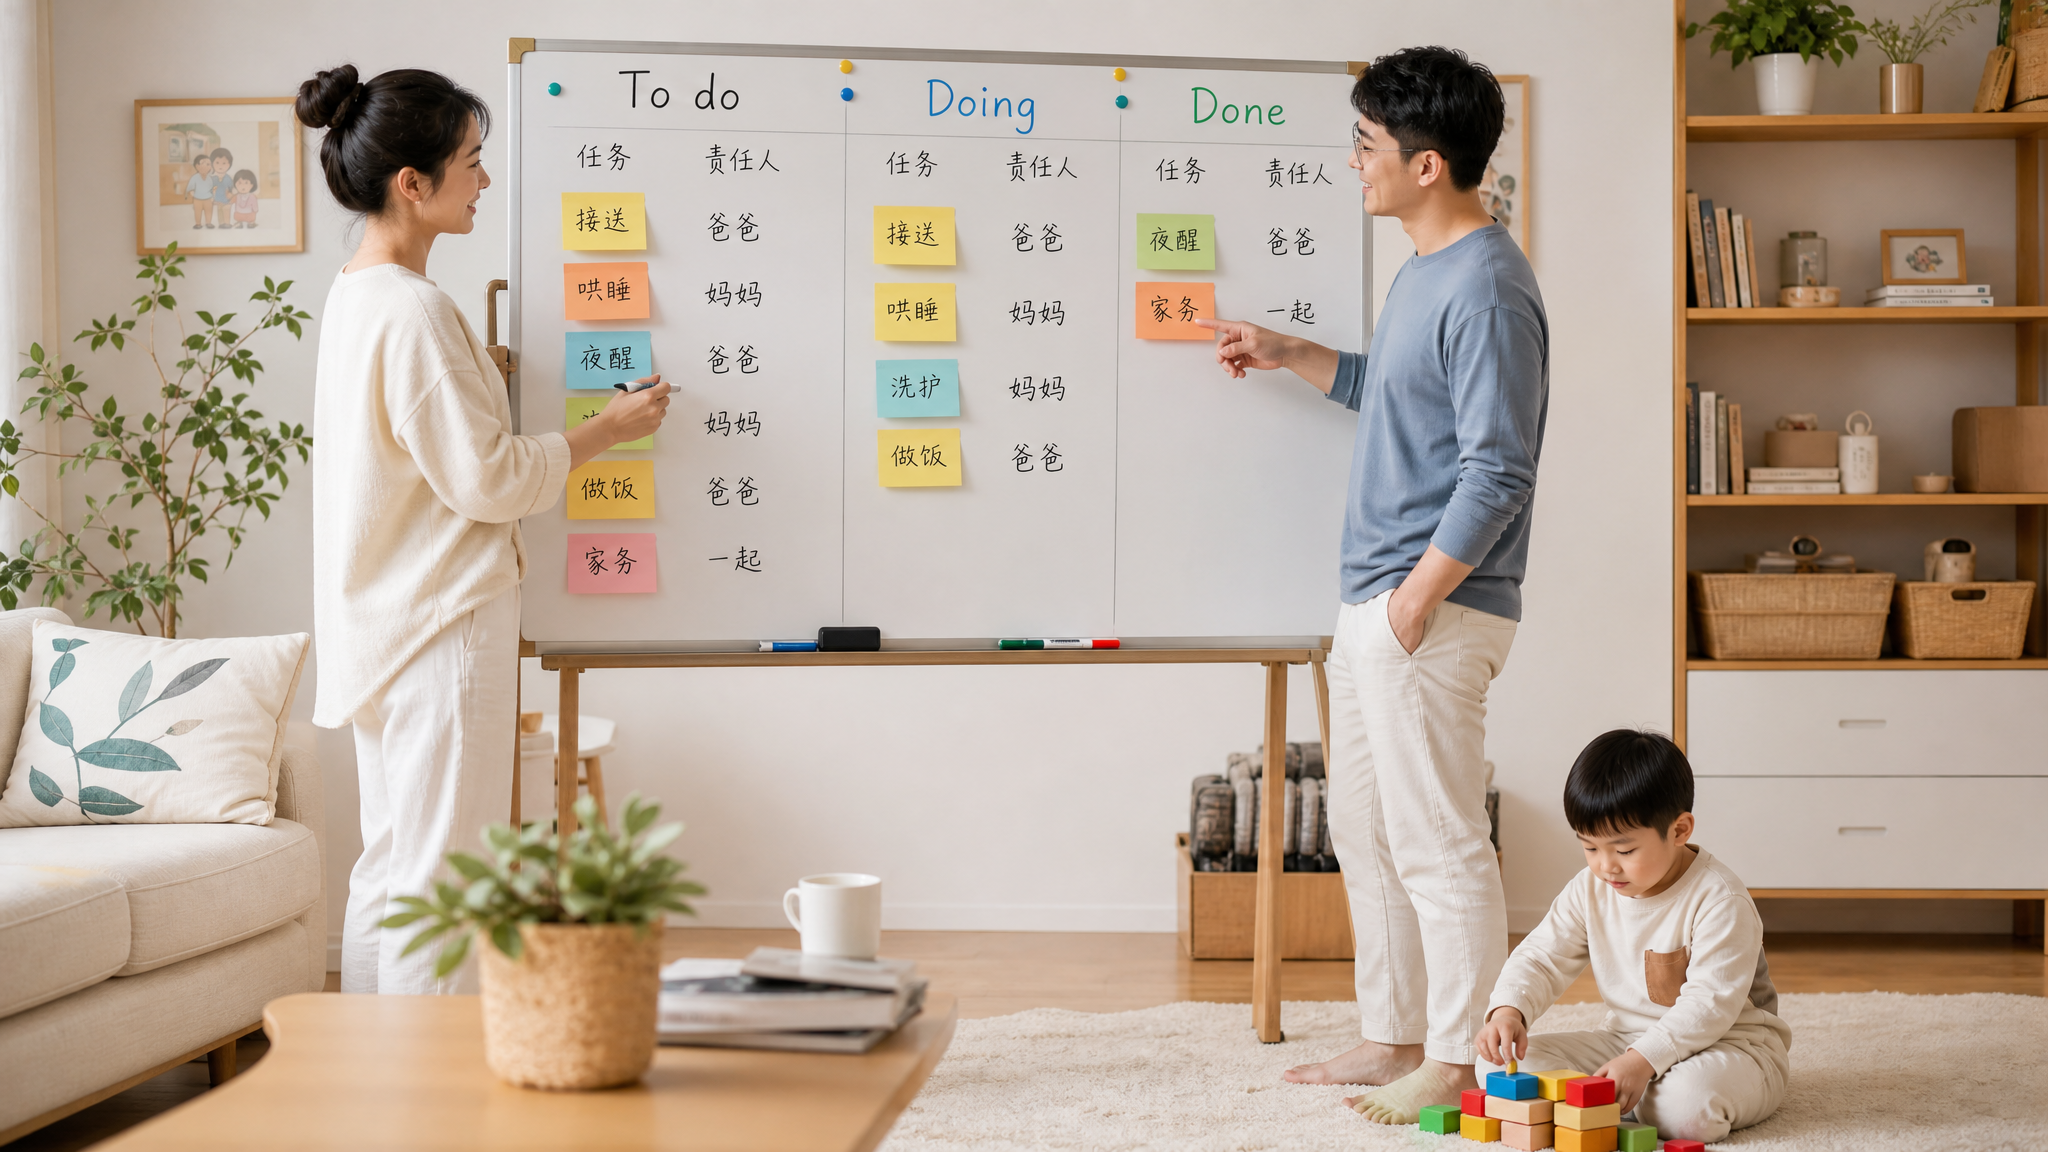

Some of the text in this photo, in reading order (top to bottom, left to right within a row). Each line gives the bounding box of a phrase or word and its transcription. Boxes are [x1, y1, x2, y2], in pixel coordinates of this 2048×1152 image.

[618, 70, 740, 111] To do
[926, 78, 1035, 135] Doing
[1190, 86, 1286, 126] Done
[576, 142, 631, 171] 任务
[705, 143, 780, 175] 责任人
[886, 150, 938, 178] 任务
[1006, 150, 1078, 182] 责任人
[1155, 156, 1206, 185] 任务
[1265, 157, 1333, 188] 责任人
[575, 206, 630, 233] 接送
[707, 212, 759, 243] 爸爸
[886, 220, 940, 247] 接送
[1011, 222, 1063, 253] 爸爸
[1149, 226, 1201, 252] 夜醒
[1267, 227, 1315, 256] 爸爸
[578, 276, 631, 302] 哄睡
[704, 281, 762, 308] 妈妈
[887, 297, 939, 322] 哄睡
[1008, 299, 1065, 327] 妈妈
[1151, 295, 1199, 323] 家务
[1266, 298, 1316, 325] 一起
[580, 344, 635, 371] 夜醒
[707, 344, 759, 375] 爸爸
[891, 373, 941, 400] 洗护
[1008, 375, 1066, 402] 妈妈
[703, 410, 761, 437] 妈妈
[891, 444, 947, 468] 做饭
[1011, 442, 1064, 473] 爸爸
[580, 476, 638, 501] 做饭
[706, 476, 759, 507] 爸爸
[585, 546, 637, 576] 家务
[708, 545, 762, 573] 一起
